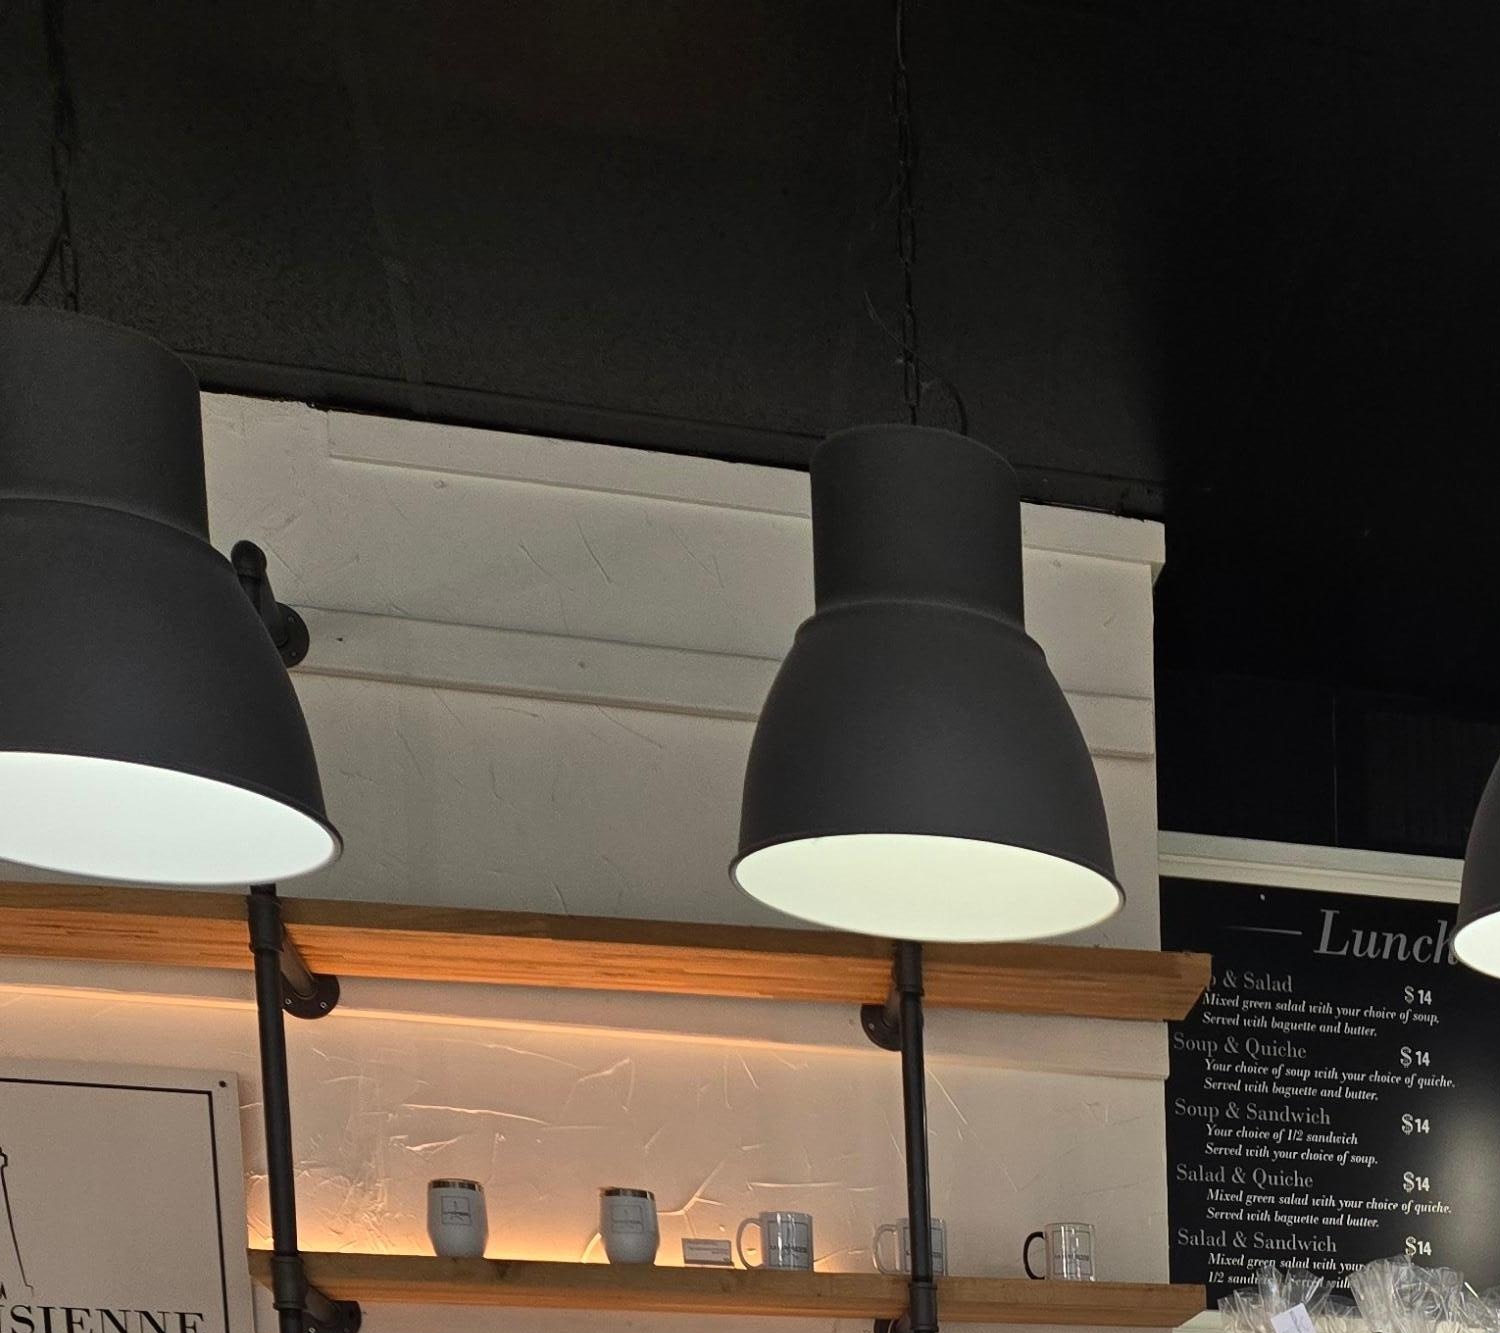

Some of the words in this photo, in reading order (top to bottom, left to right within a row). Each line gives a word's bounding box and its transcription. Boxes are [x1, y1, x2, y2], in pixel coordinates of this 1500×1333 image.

[1222, 970, 1238, 988] &
[1243, 972, 1293, 992] Salad
[1173, 1031, 1218, 1058] Soup
[1224, 1036, 1240, 1052] &
[1246, 1037, 1307, 1059] Quiche
[1174, 1100, 1219, 1122] Soup
[1226, 1102, 1240, 1119] &
[1246, 1102, 1331, 1125] Sandwich
[1206, 1124, 1234, 1138] Your
[1236, 1126, 1270, 1140] choice
[1272, 1128, 1286, 1144] of
[1306, 1130, 1358, 1146] sandwich
[1176, 1164, 1225, 1184] Salad
[1231, 1166, 1246, 1184] &
[1252, 1168, 1314, 1189] Quiche
[1178, 1228, 1226, 1248] Salad
[1232, 1232, 1248, 1248] &
[1252, 1232, 1337, 1253] Sandwich
